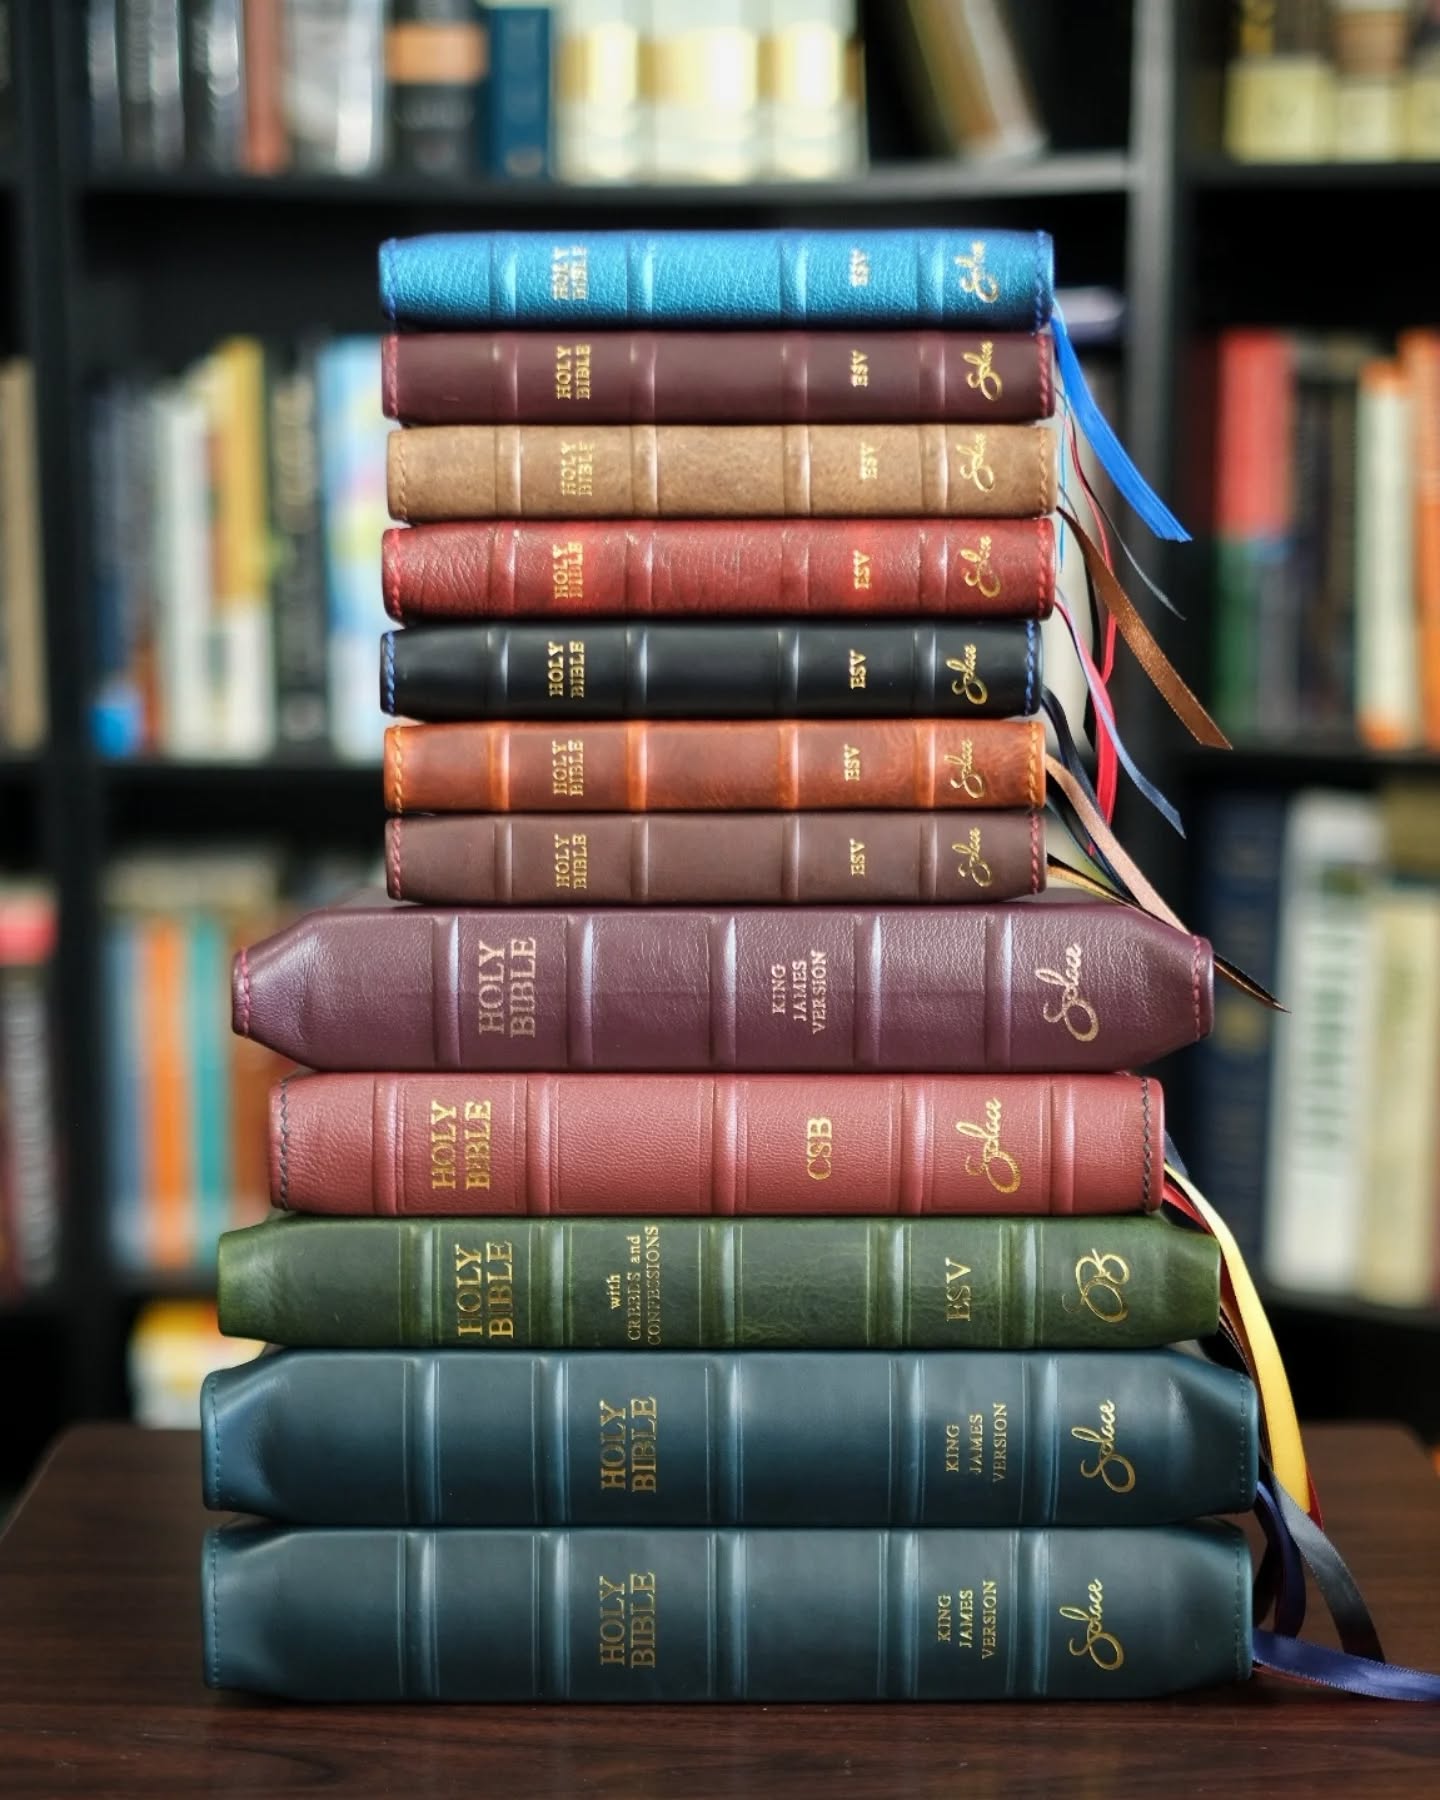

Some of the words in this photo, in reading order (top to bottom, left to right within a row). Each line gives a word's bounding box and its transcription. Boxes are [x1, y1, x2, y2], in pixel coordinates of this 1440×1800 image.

[552, 247, 570, 300] HOLY
[571, 246, 588, 300] BIBLE
[850, 248, 869, 287] ESV
[556, 346, 572, 399] HOLY
[576, 344, 591, 400] BIBLE
[851, 349, 869, 387] ESV
[561, 441, 577, 495] HOLY
[579, 440, 594, 496] BIBLE
[860, 442, 878, 480] ESV
[553, 544, 569, 598] HOLY
[568, 541, 584, 598] BIBLE
[853, 549, 871, 590] ESV
[548, 641, 564, 697] HOLY
[569, 640, 585, 698] BIBLE
[849, 648, 867, 690] ESV
[552, 740, 568, 795] HOLY
[568, 739, 584, 796] BIBLE
[843, 743, 860, 781] ESV
[554, 833, 570, 888] HOLY
[572, 832, 587, 889] BIBLE
[849, 838, 866, 876] ESV
[478, 940, 505, 1035] HOLY
[510, 937, 537, 1038] BIBLE
[771, 963, 787, 1014] KING
[793, 959, 808, 1022] JAMES
[812, 950, 828, 1035] VERSION
[430, 1101, 457, 1190] HOLY
[464, 1099, 492, 1190] BIBLE
[807, 1116, 833, 1181] CSB
[626, 1234, 641, 1264] and
[456, 1244, 483, 1337] HOLY
[485, 1239, 514, 1340] BIBLE
[606, 1272, 621, 1309] with
[626, 1271, 641, 1341] CREEDS
[644, 1225, 661, 1345] CONFESSIONS
[945, 1257, 973, 1323] ESV
[599, 1399, 627, 1491] HOLY
[630, 1395, 658, 1493] BIBLE
[945, 1423, 960, 1473] KING
[969, 1413, 984, 1475] JAMES
[992, 1402, 1007, 1484] VERSION
[599, 1575, 626, 1667] HOLY
[629, 1571, 657, 1670] BIBLE
[937, 1593, 953, 1643] KING
[959, 1588, 974, 1649] JAMES
[982, 1579, 998, 1660] VERSION
